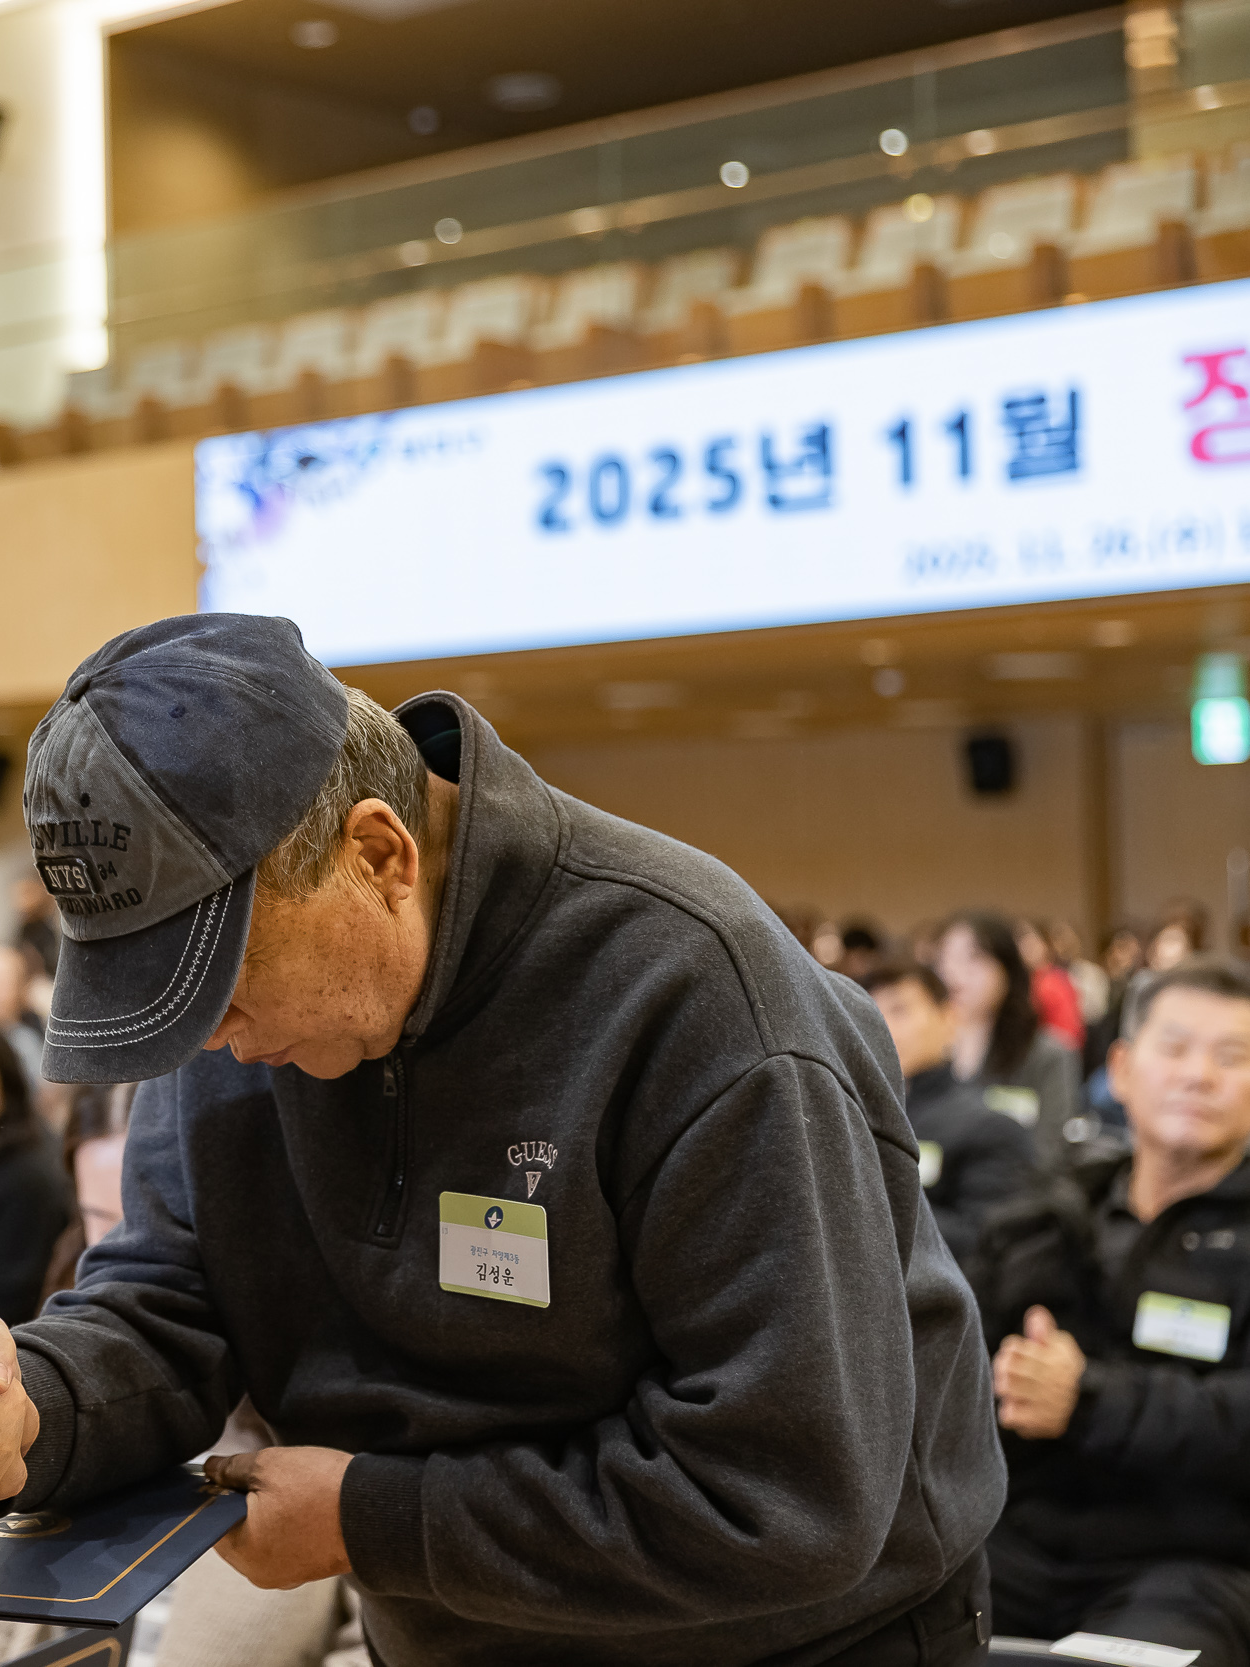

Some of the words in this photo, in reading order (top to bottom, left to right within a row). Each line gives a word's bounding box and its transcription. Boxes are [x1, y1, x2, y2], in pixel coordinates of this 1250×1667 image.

[534, 424, 833, 532] 2025년
[886, 389, 1081, 484] 11월
[507, 1141, 558, 1169] GUESS
[470, 1245, 488, 1257] 광진구
[476, 1262, 515, 1287] 김성운
